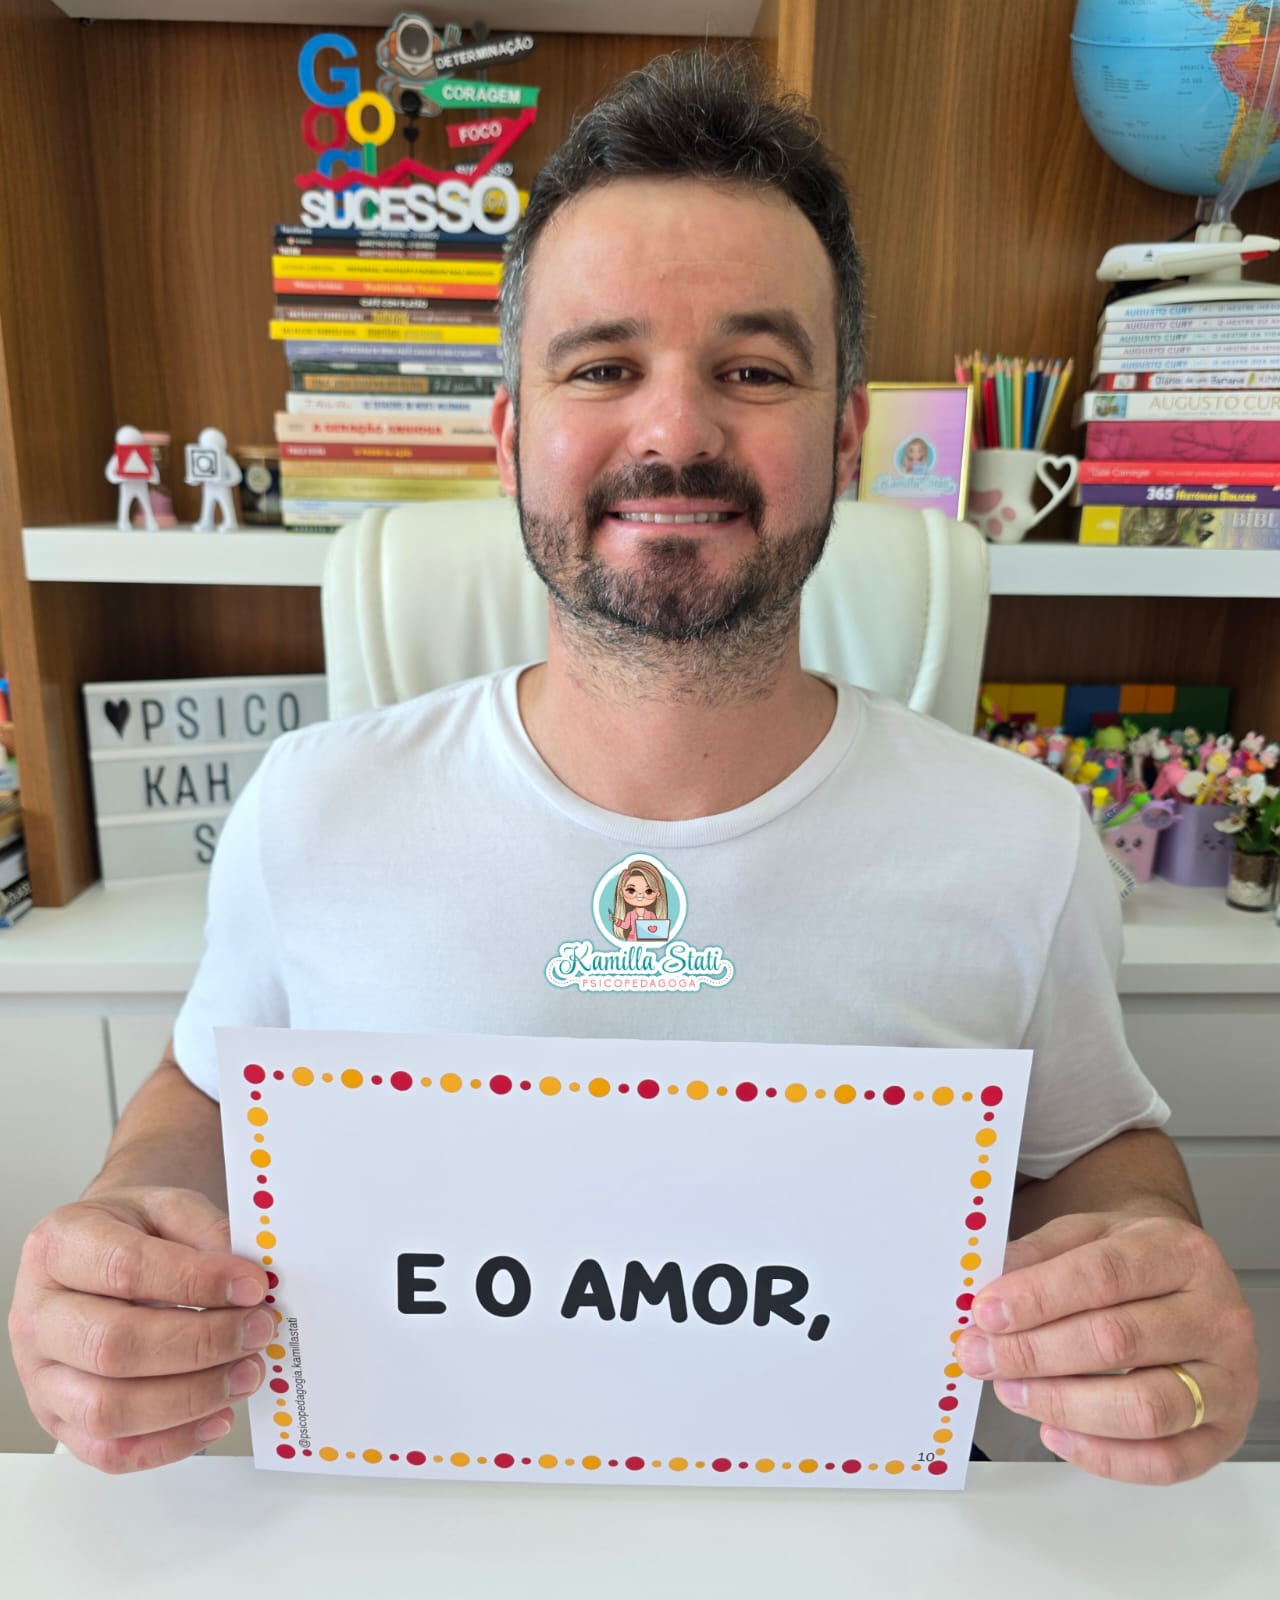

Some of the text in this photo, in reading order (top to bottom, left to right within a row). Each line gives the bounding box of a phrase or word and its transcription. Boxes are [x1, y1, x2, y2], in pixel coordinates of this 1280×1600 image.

[435, 35, 534, 71] DETERMINAÇÃO
[442, 85, 521, 105] CORAGEM
[458, 122, 502, 143] FOCO
[300, 176, 521, 235] SUCESSO
[1124, 305, 1193, 317] AUGUSTO CURY
[1124, 319, 1193, 330] AUGUSTO CURY
[1120, 333, 1188, 344] AUGUSTO CURY
[1123, 346, 1191, 355] AUGUSTO CURY
[1121, 360, 1188, 369] AUGUSTO CURY
[1150, 395, 1240, 411] AUGUSTO
[1146, 486, 1174, 501] 365
[141, 692, 300, 741] PSICO
[145, 762, 231, 807] KAH
[397, 1253, 831, 1342] E O AMOR,
[286, 1317, 312, 1449] @psicopedagogia.kamillastati
[917, 1451, 936, 1463] 10
